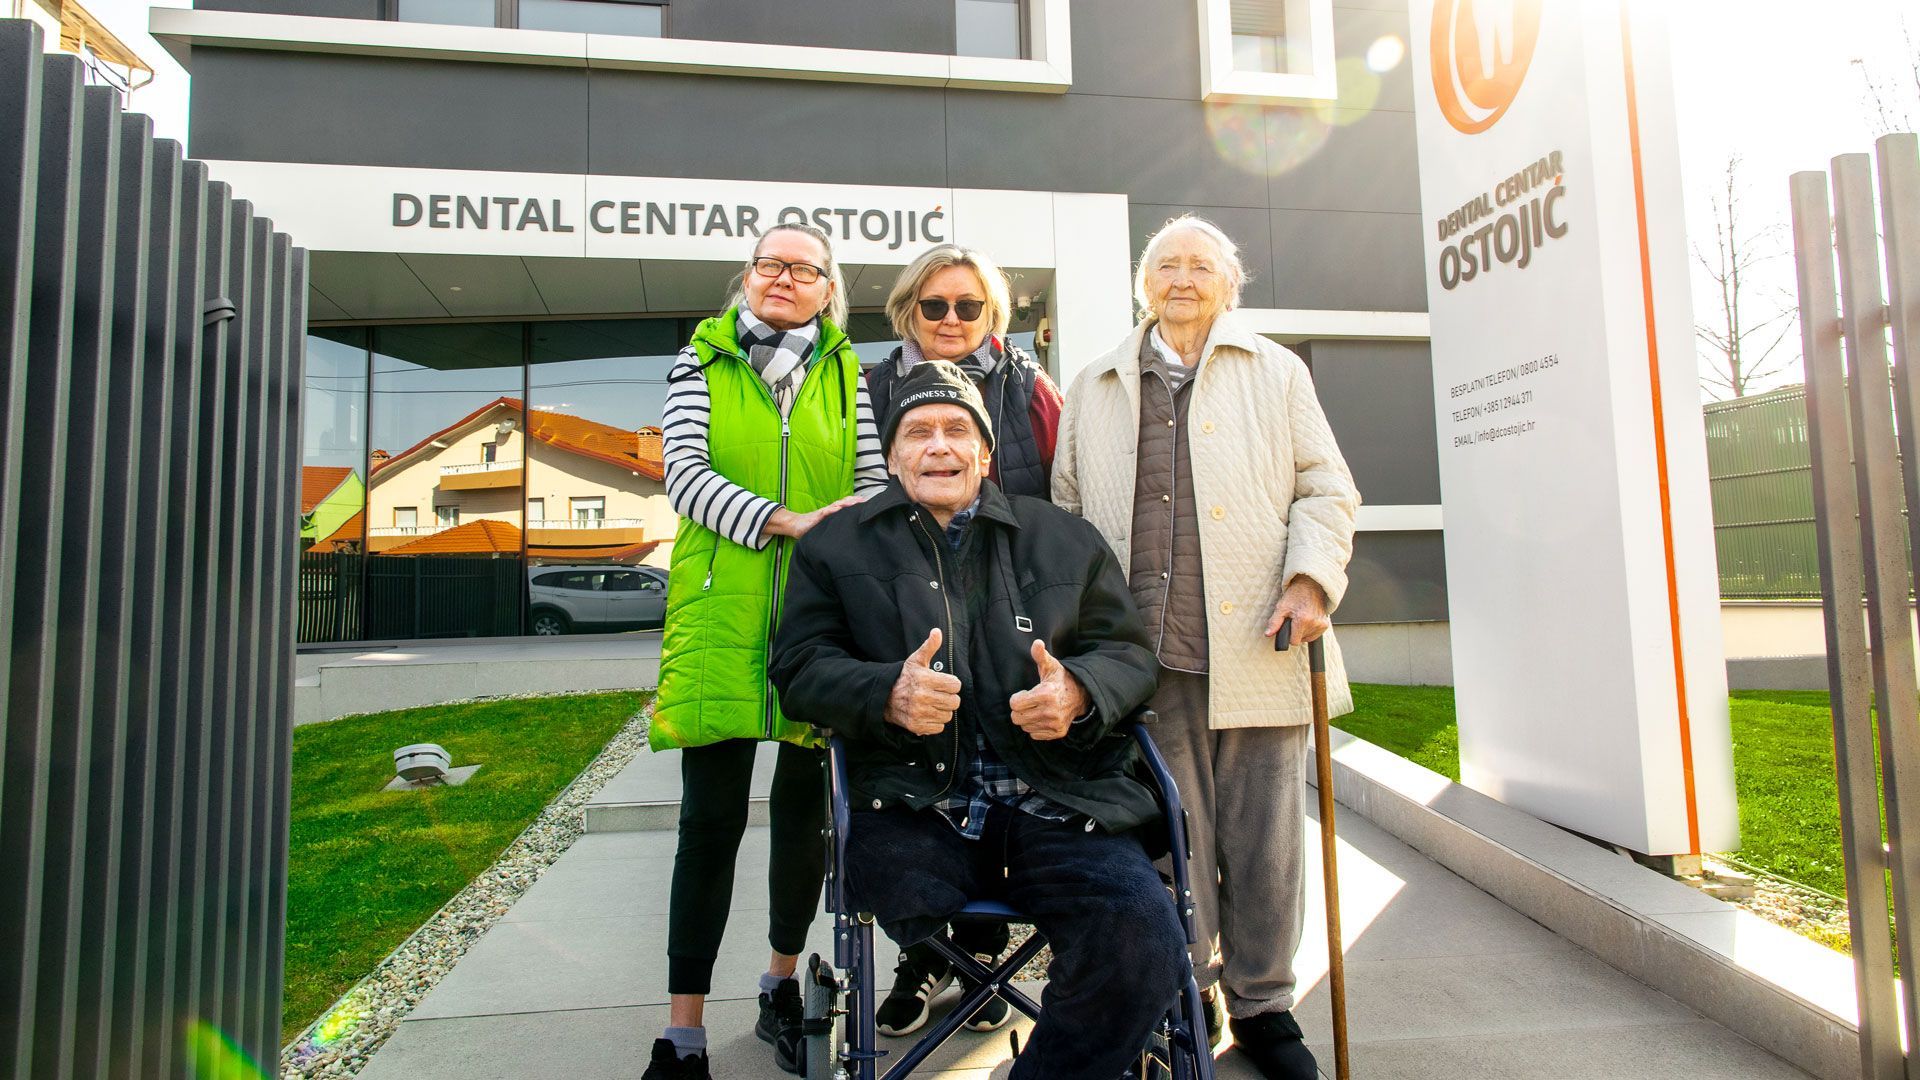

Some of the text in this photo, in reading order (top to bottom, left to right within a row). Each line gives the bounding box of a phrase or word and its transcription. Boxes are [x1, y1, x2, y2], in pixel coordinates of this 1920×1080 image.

[1438, 150, 1564, 242] DENTAL CENTAR
[392, 192, 945, 250] DENTAL CENTAR OSTOJIĆ
[1439, 174, 1569, 291] OSTOJIĆ
[1450, 378, 1485, 398] BESPLATNI
[1520, 360, 1538, 376] 0800
[1540, 353, 1559, 369] 4554
[1521, 390, 1533, 405] 371
[900, 390, 945, 407] GUINNESS
[1454, 433, 1473, 447] EMAIL
[1478, 420, 1535, 441] info@dcostojic.hr
